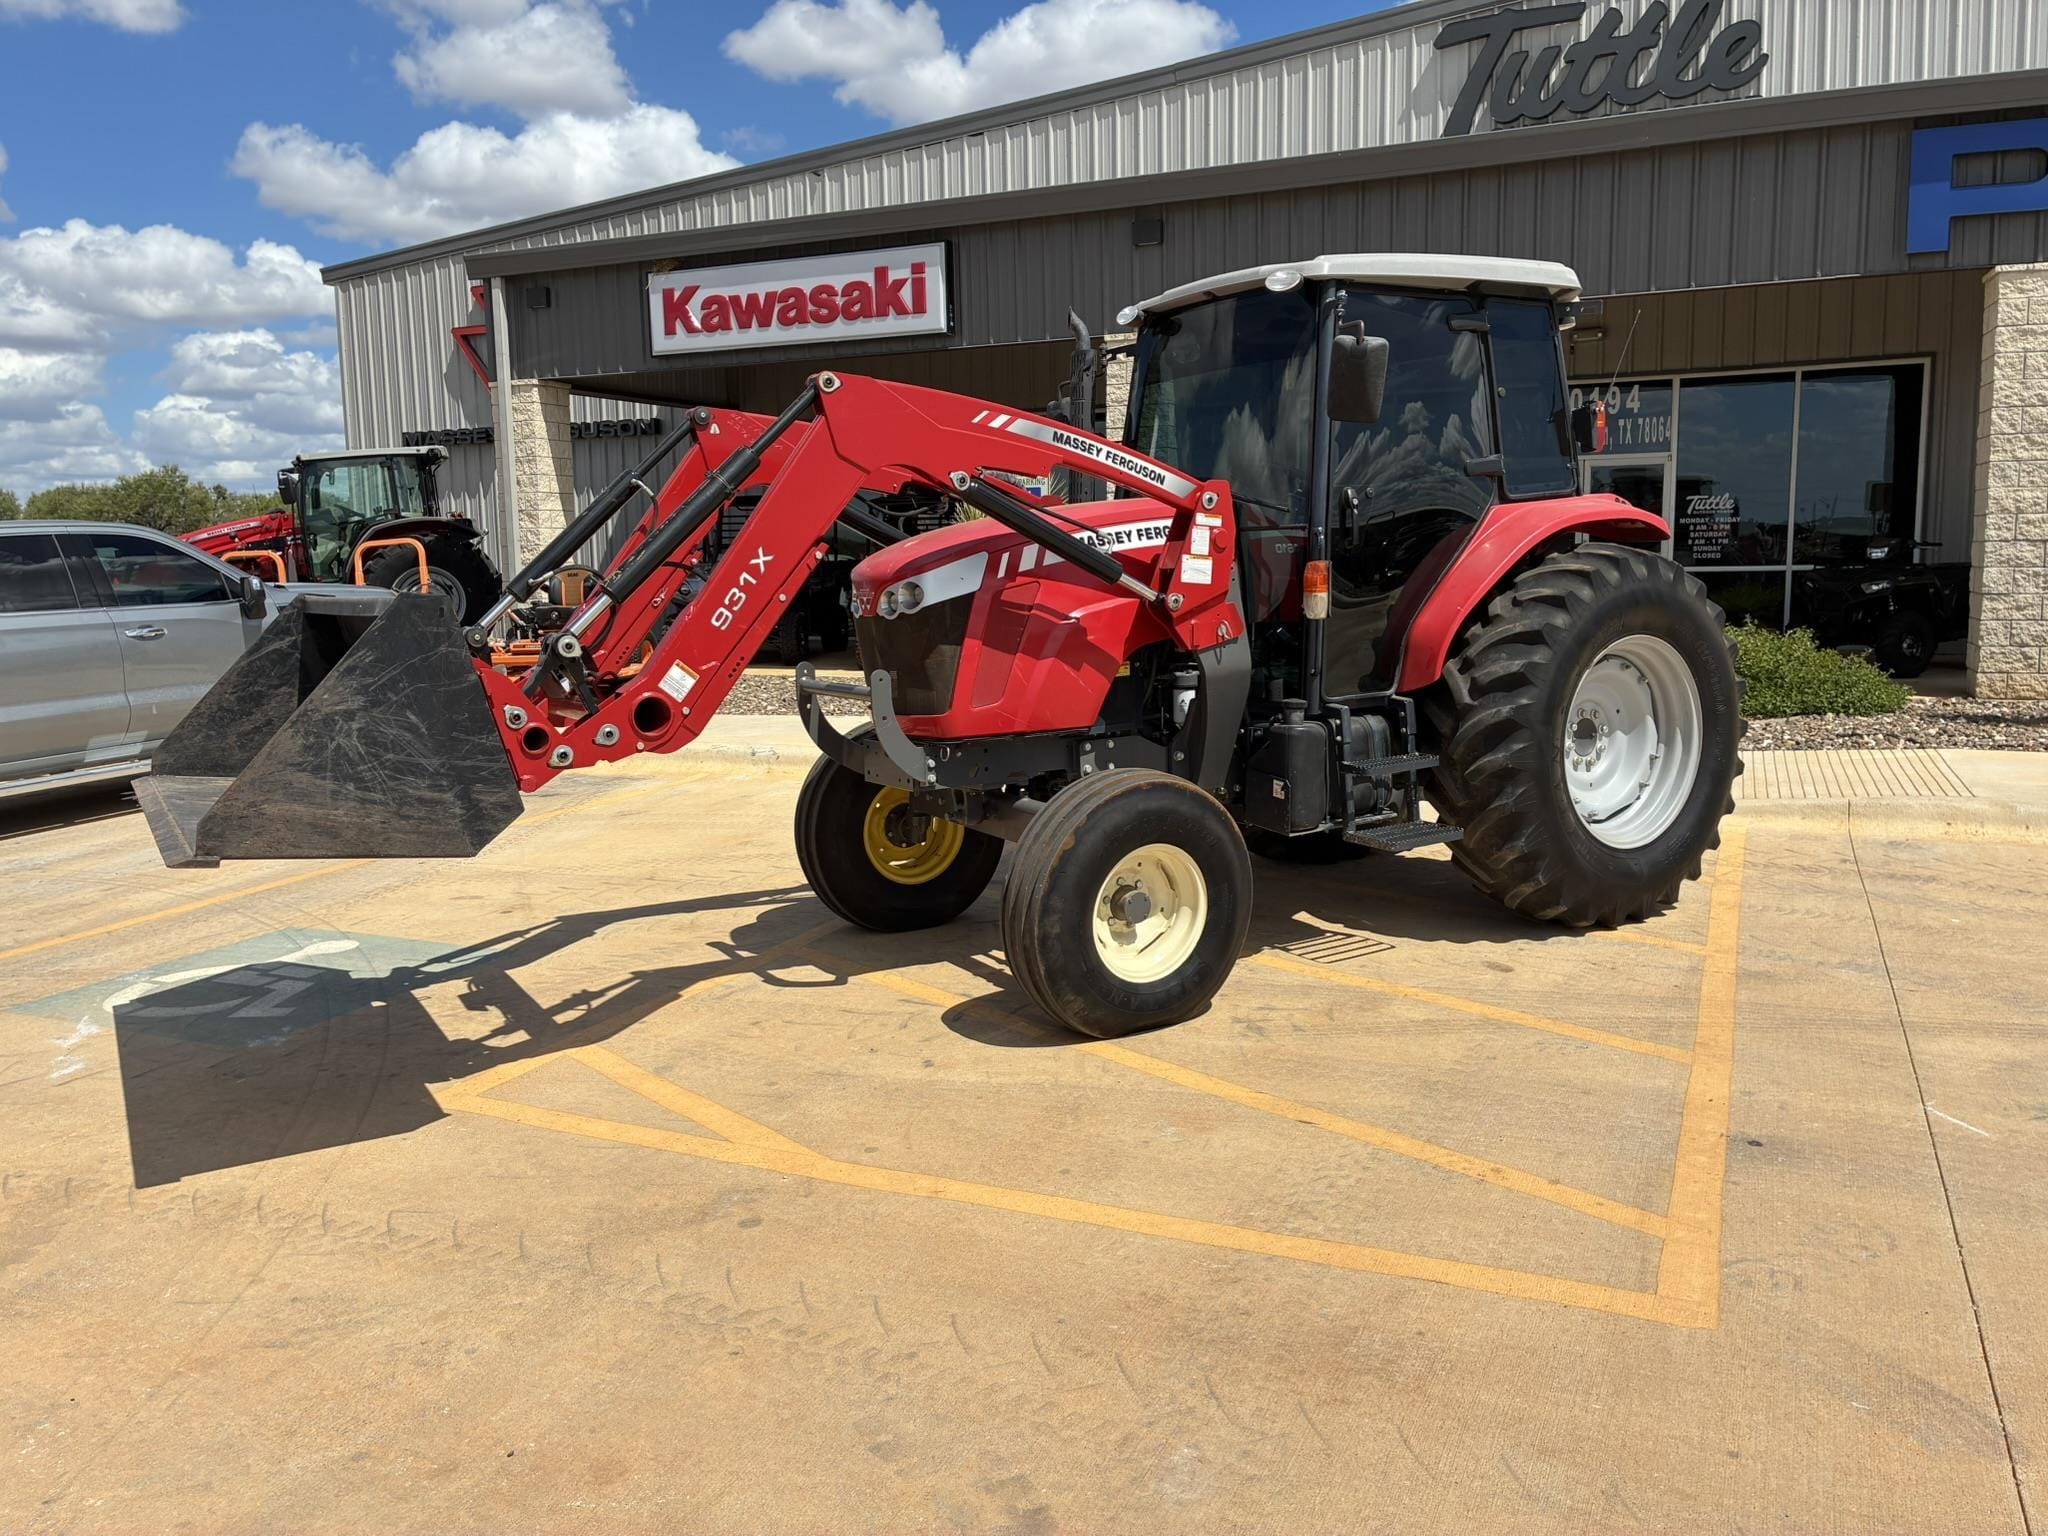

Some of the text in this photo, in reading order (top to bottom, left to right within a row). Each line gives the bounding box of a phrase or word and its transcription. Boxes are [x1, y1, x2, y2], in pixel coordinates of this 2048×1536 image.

[1434, 0, 1769, 136] Tuttle
[662, 262, 927, 337] Kawasaki
[1052, 430, 1166, 486] MASSEY FERGUSON
[1618, 418, 1632, 445] TX
[1638, 415, 1671, 444] 78064
[1686, 492, 1736, 515] Tuttle
[711, 546, 775, 631] 931X
